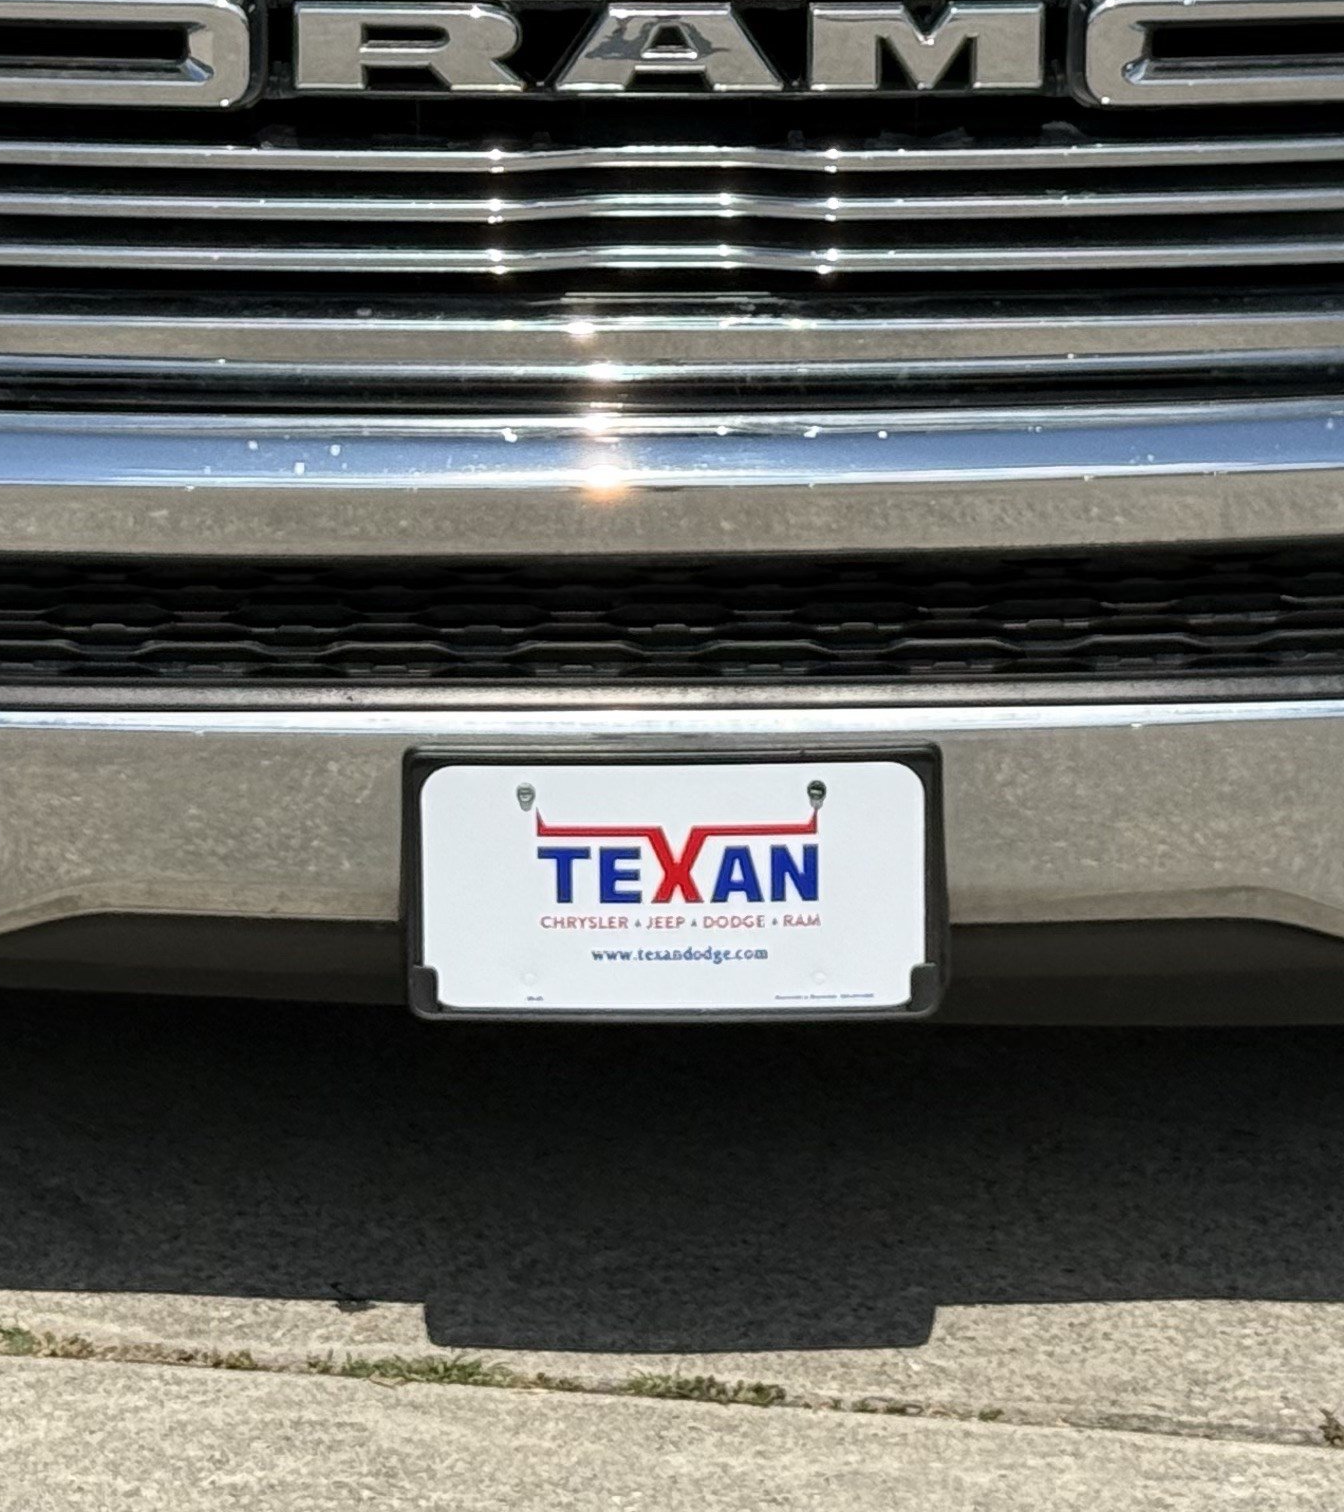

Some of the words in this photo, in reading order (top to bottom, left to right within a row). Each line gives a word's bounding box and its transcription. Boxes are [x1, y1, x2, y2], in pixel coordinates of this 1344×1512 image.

[295, 0, 1043, 90] RAM
[537, 826, 819, 904] TEXAN
[540, 915, 629, 930] CHRYSLER
[646, 915, 686, 929] JEEP
[703, 915, 765, 929] DODGE
[783, 914, 822, 928] RAM
[591, 946, 768, 963] www.texandodge.com
